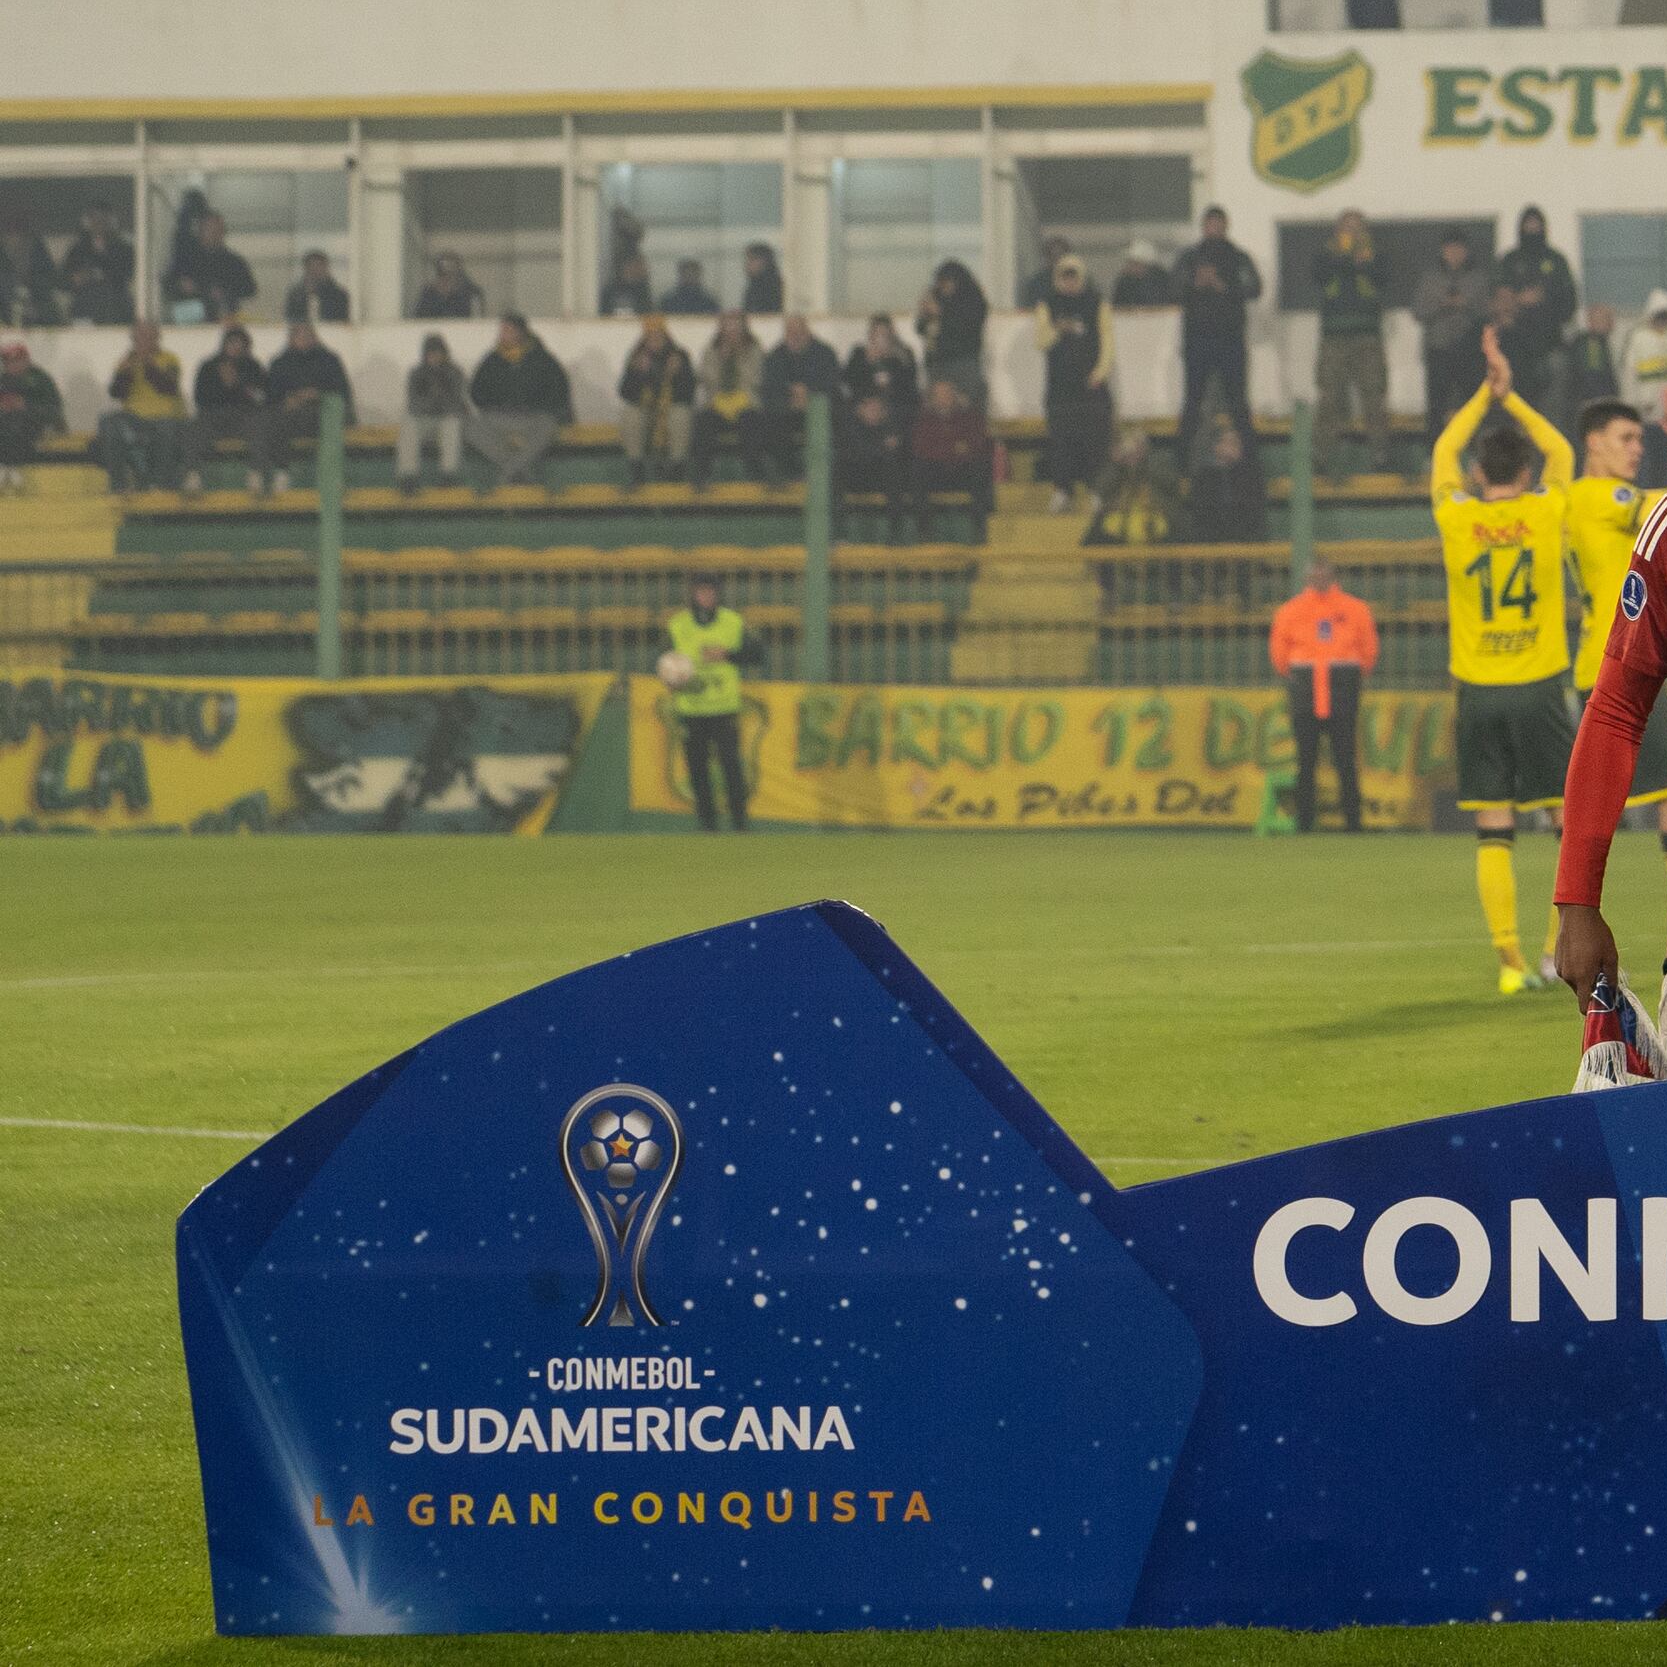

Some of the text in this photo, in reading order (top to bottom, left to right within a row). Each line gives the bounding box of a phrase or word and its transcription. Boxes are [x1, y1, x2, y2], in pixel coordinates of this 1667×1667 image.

[1465, 548, 1538, 622] 14
[796, 694, 1063, 772] BARRIO
[1094, 695, 1173, 772] 12
[35, 734, 150, 812] LA
[389, 1406, 854, 1455] SUDAMERICANA
[313, 1490, 932, 1531] LA GRAN CONQUISTA
